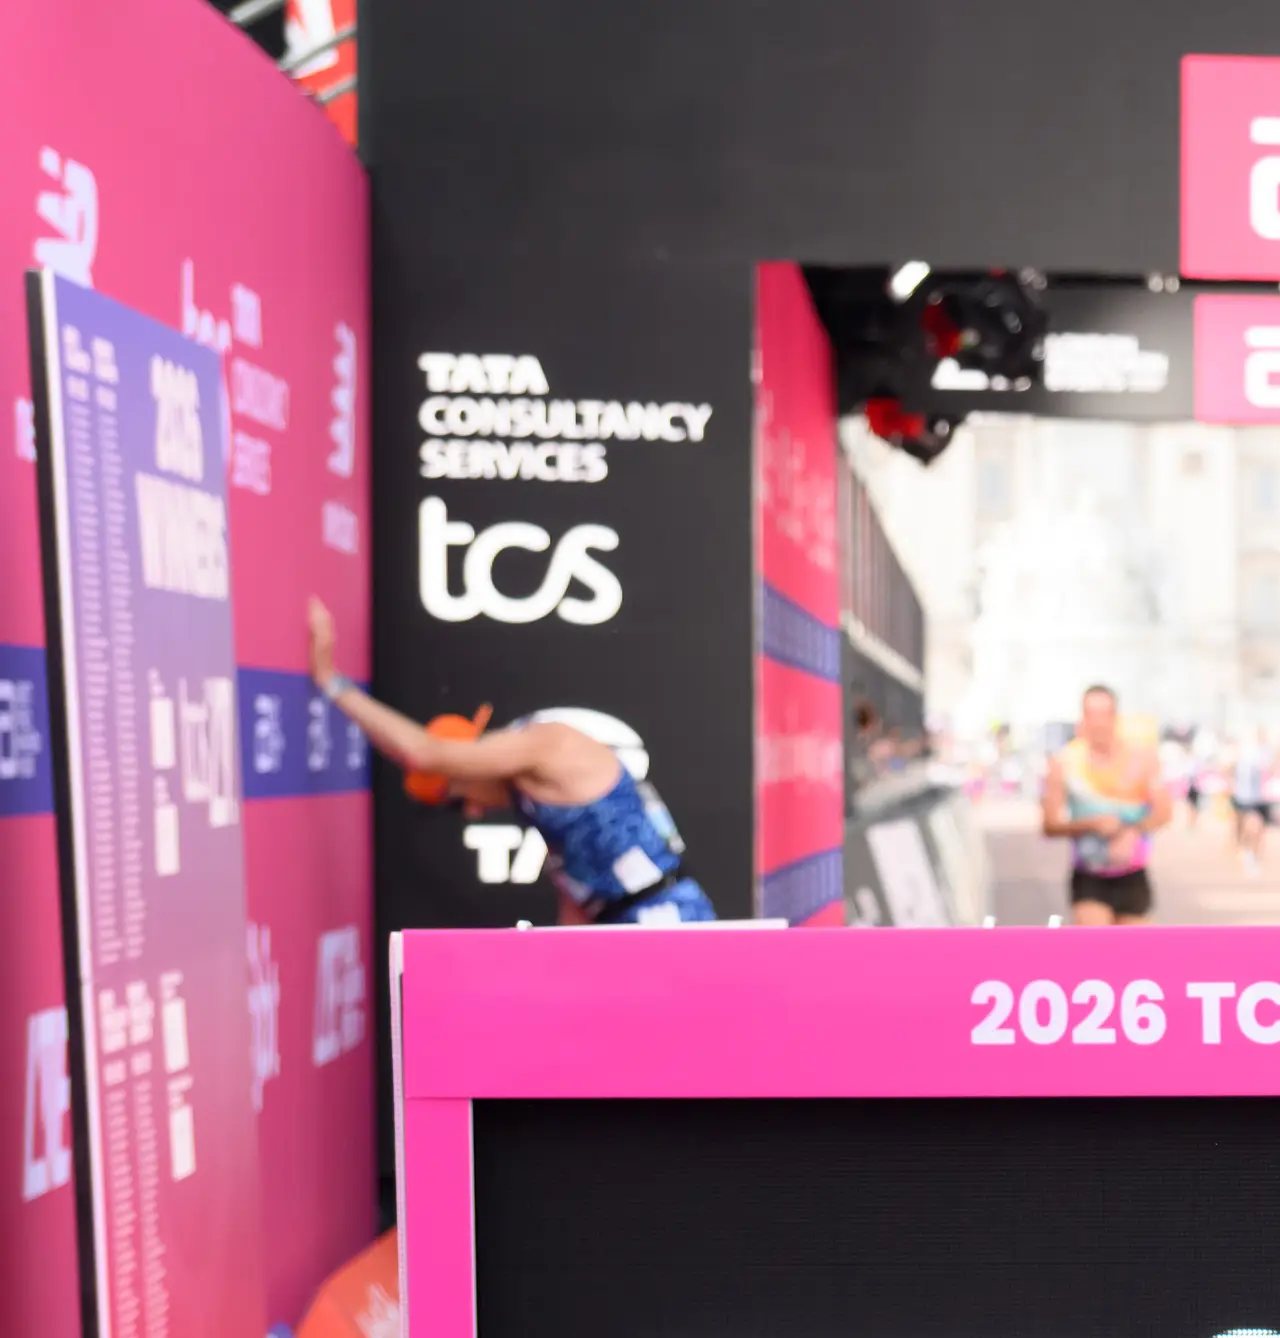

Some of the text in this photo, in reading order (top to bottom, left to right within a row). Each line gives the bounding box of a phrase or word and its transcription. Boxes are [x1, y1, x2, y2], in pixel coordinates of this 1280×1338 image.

[418, 353, 549, 394] TATA
[418, 396, 713, 442] CONSULTANCY
[420, 439, 608, 482] SERVICES
[420, 496, 623, 625] tcs
[971, 979, 1167, 1045] 2026
